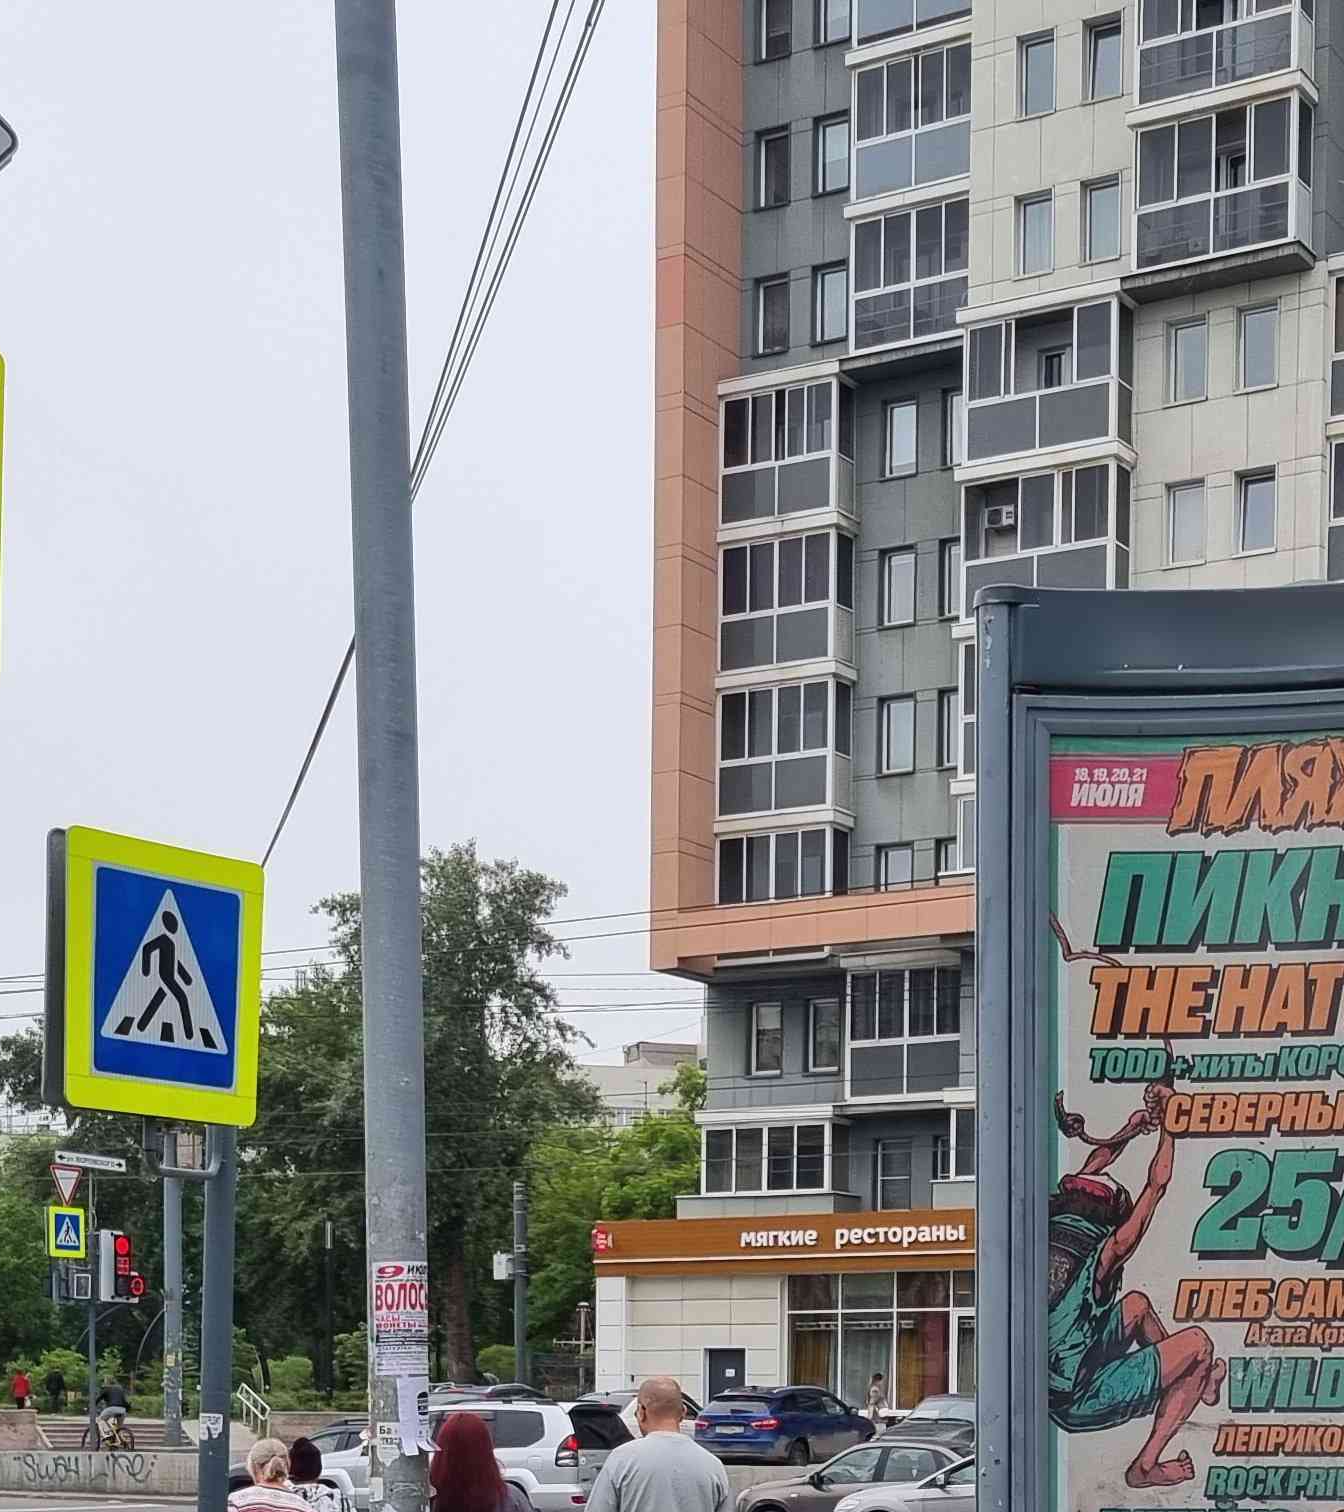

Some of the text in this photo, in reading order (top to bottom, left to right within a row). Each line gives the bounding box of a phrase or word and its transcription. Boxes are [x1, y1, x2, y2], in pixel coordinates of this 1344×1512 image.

[1070, 783, 1146, 807] ИЮЛЯ
[1090, 965, 1213, 1038] THE
[1090, 1048, 1168, 1082] TODD
[740, 1224, 966, 1249] мягкие рестораны
[377, 1265, 404, 1278] 9
[1173, 1278, 1275, 1322] ГЛЕБ
[1245, 1324, 1307, 1346] Агата
[1204, 1466, 1288, 1500] ROCK
